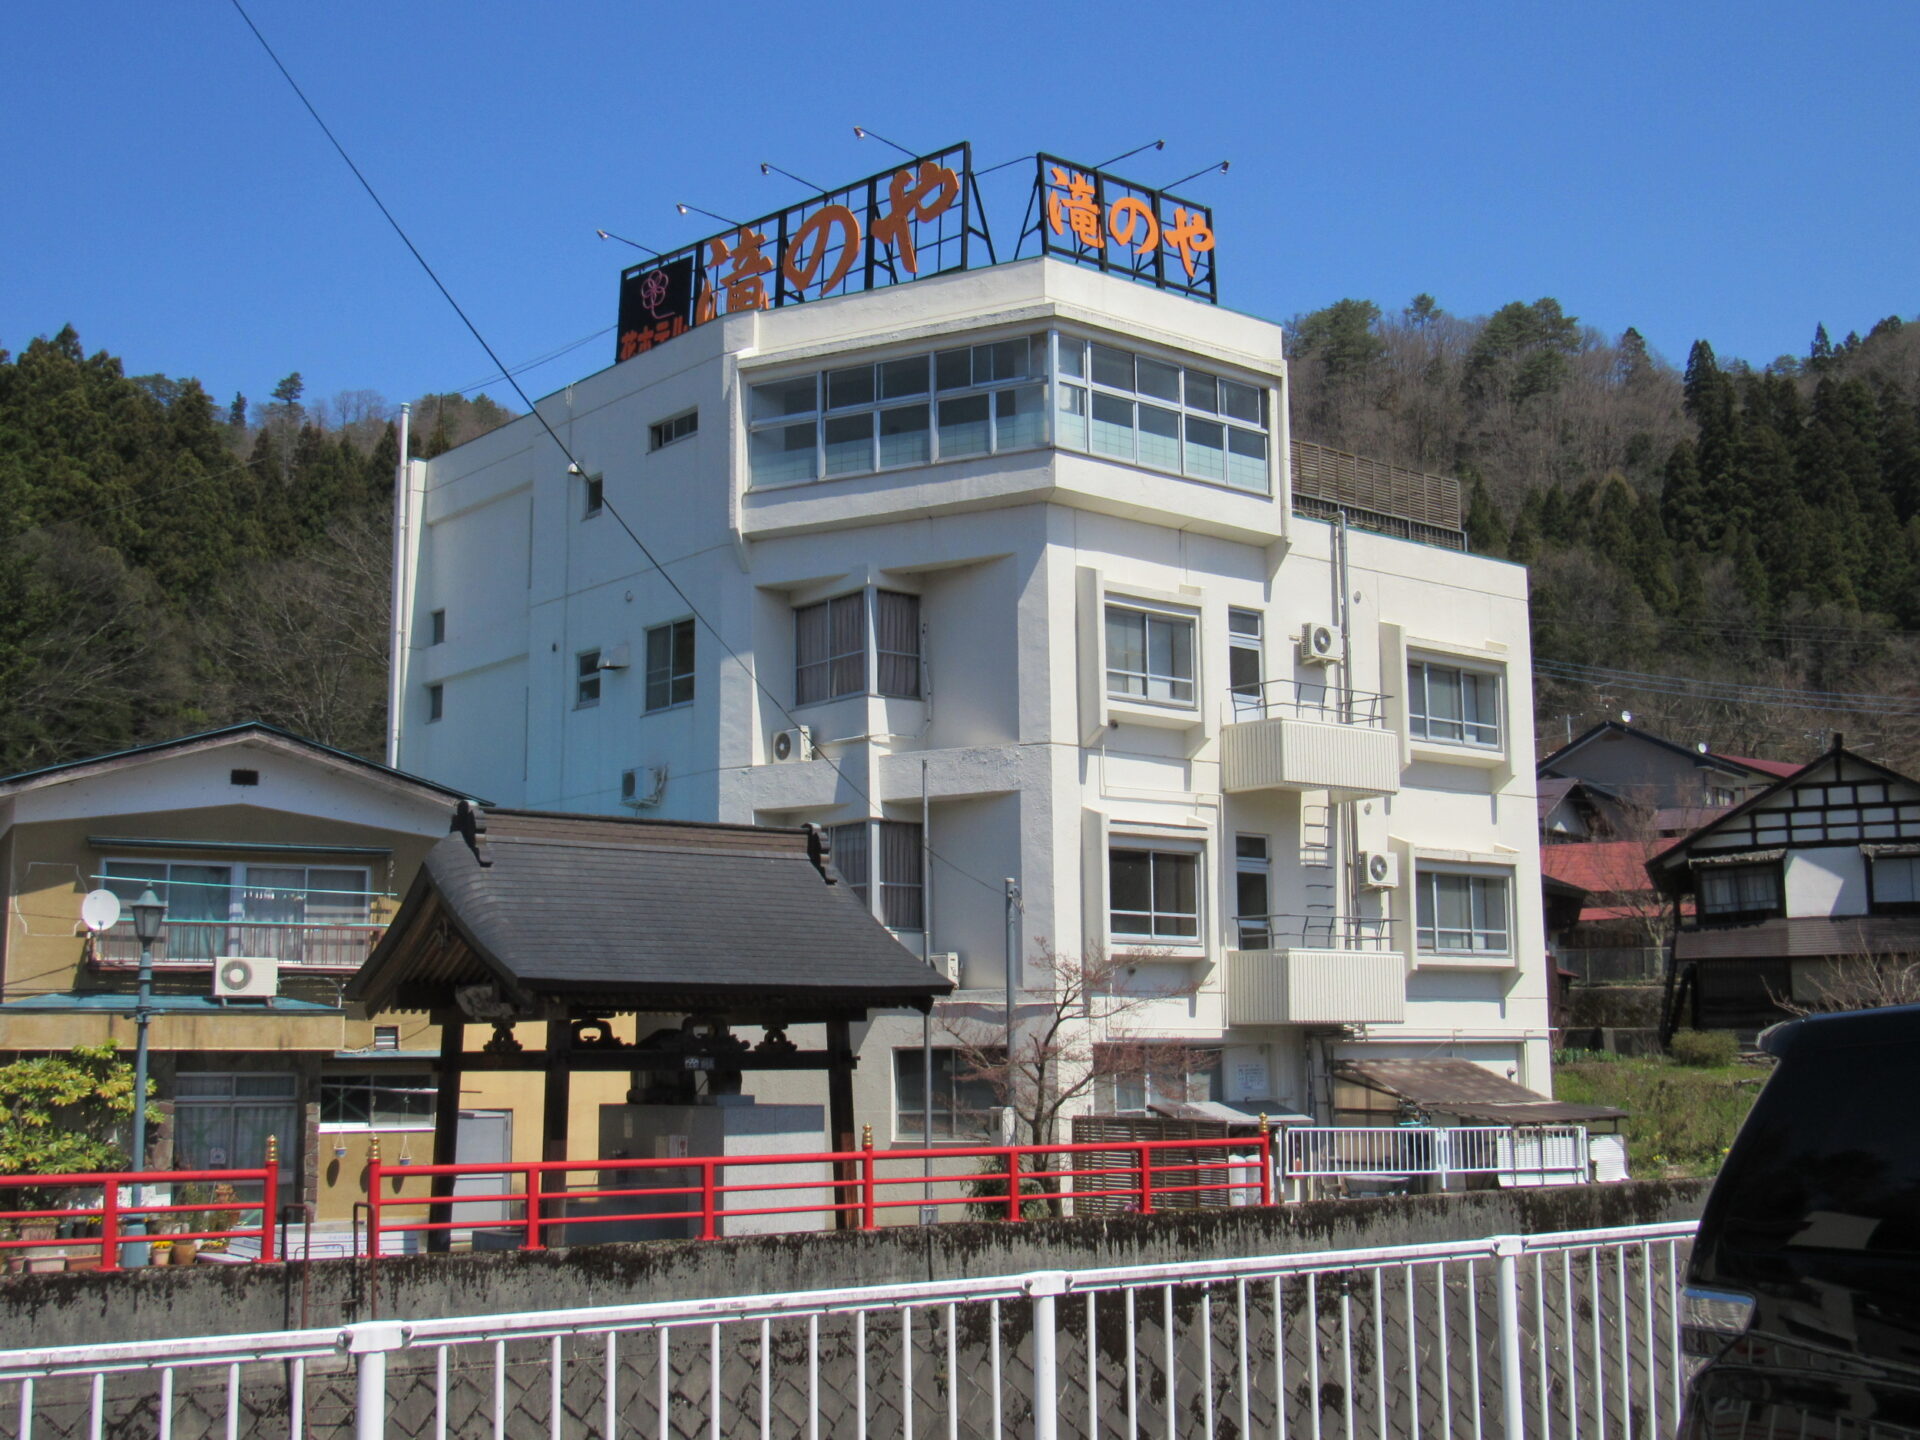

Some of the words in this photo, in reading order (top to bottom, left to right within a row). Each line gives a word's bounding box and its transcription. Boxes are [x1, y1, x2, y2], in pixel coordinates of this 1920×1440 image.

[695, 161, 960, 325] 滝のや
[1048, 167, 1216, 278] 滝のや
